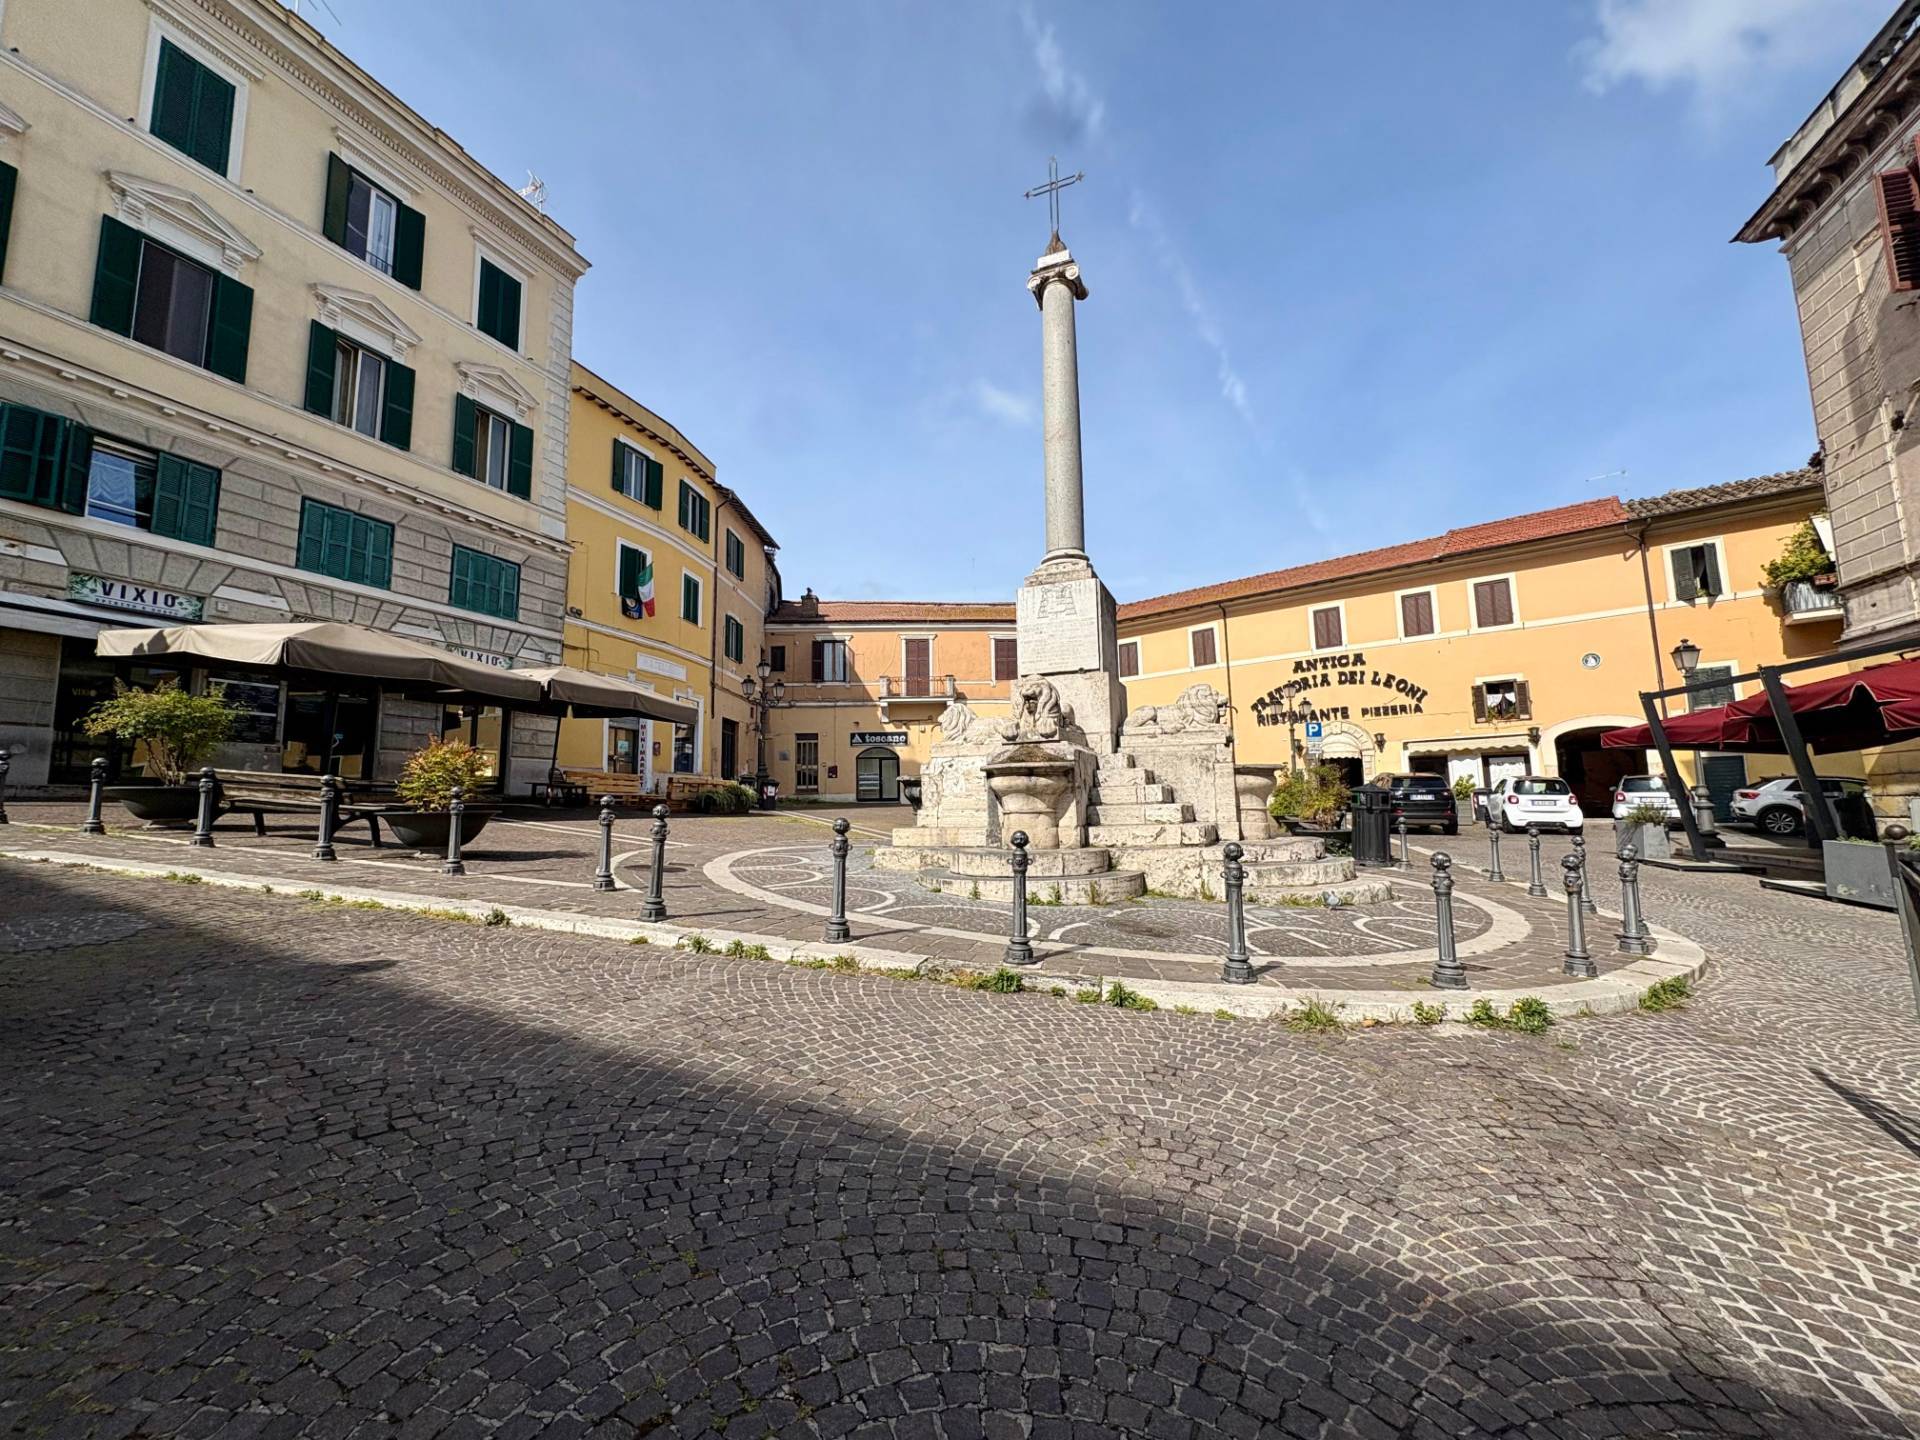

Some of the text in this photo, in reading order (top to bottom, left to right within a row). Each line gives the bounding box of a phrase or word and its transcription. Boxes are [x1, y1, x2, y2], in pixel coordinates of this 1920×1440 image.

[101, 582, 177, 608] VIXIO
[461, 650, 499, 666] VIXIO
[1293, 653, 1365, 673] ANTICA
[1251, 671, 1428, 714] TRATORIA DEI LEONI
[1361, 703, 1424, 718] PIZZERIA
[865, 734, 906, 743] toscano
[1308, 724, 1319, 736] P
[639, 724, 647, 788] MINIMARKET
